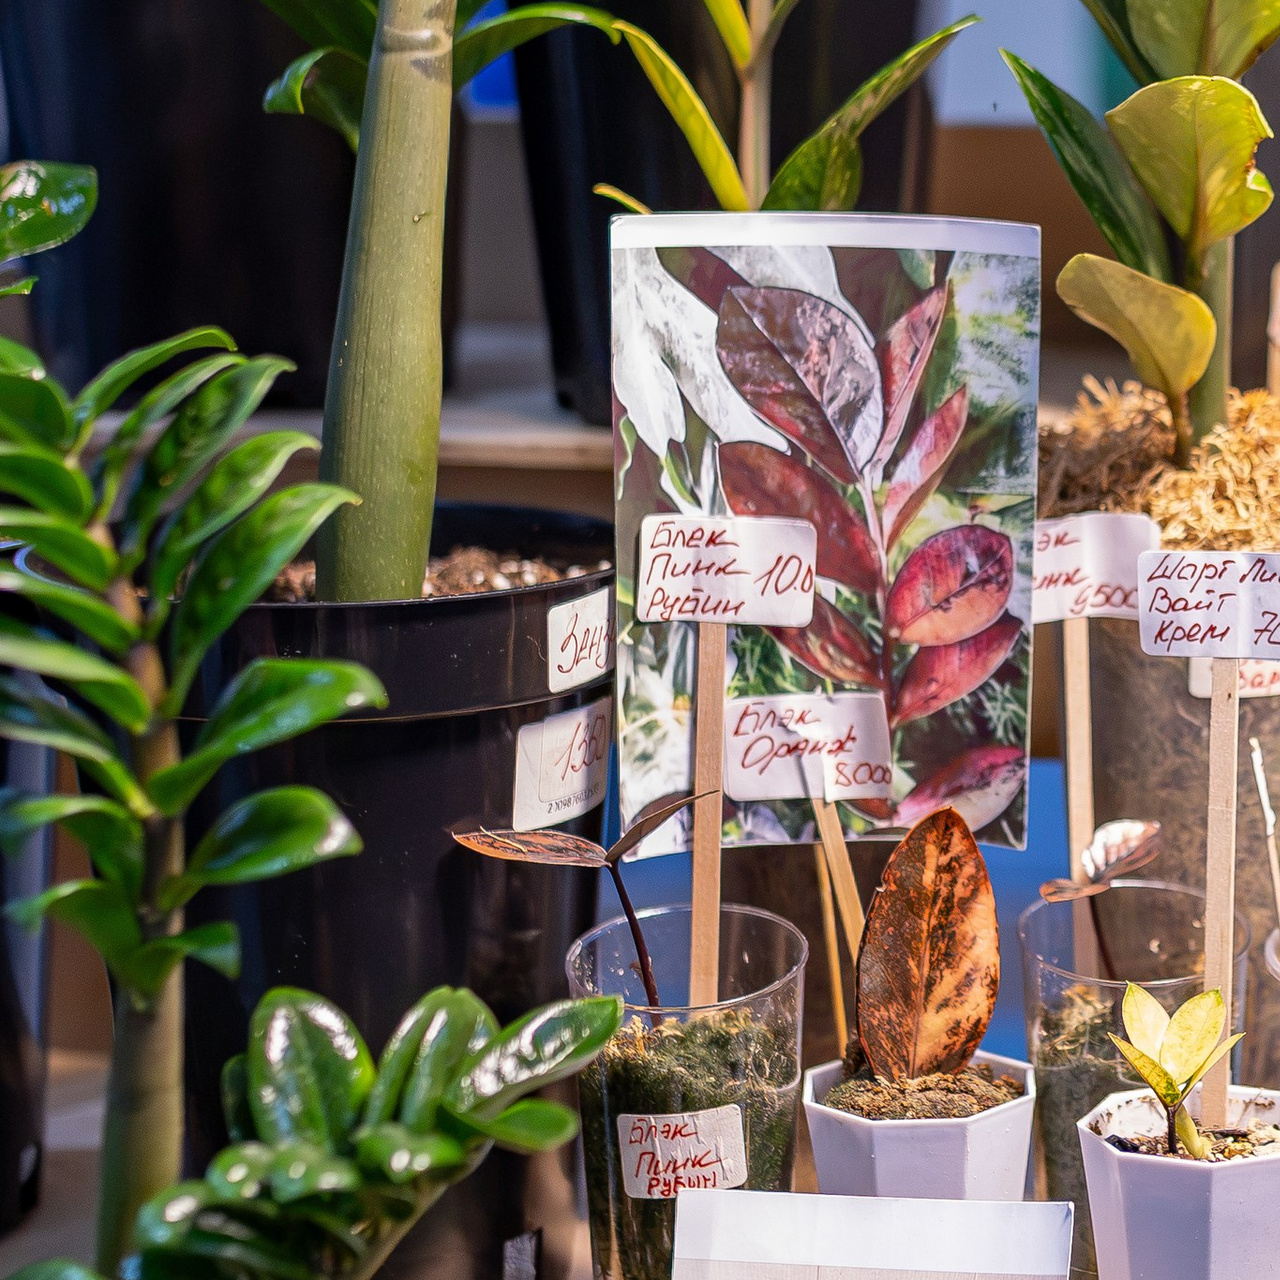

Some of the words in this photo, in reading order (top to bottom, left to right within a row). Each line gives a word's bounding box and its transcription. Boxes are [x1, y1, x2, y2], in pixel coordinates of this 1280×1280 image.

[650, 521, 740, 549] Блек
[646, 553, 751, 586] Пинк
[646, 587, 746, 621] Рубин
[1149, 586, 1237, 614] Вайт
[1154, 620, 1231, 652] Крем
[629, 1118, 699, 1145] Блэк
[635, 1149, 729, 1179] Пинк
